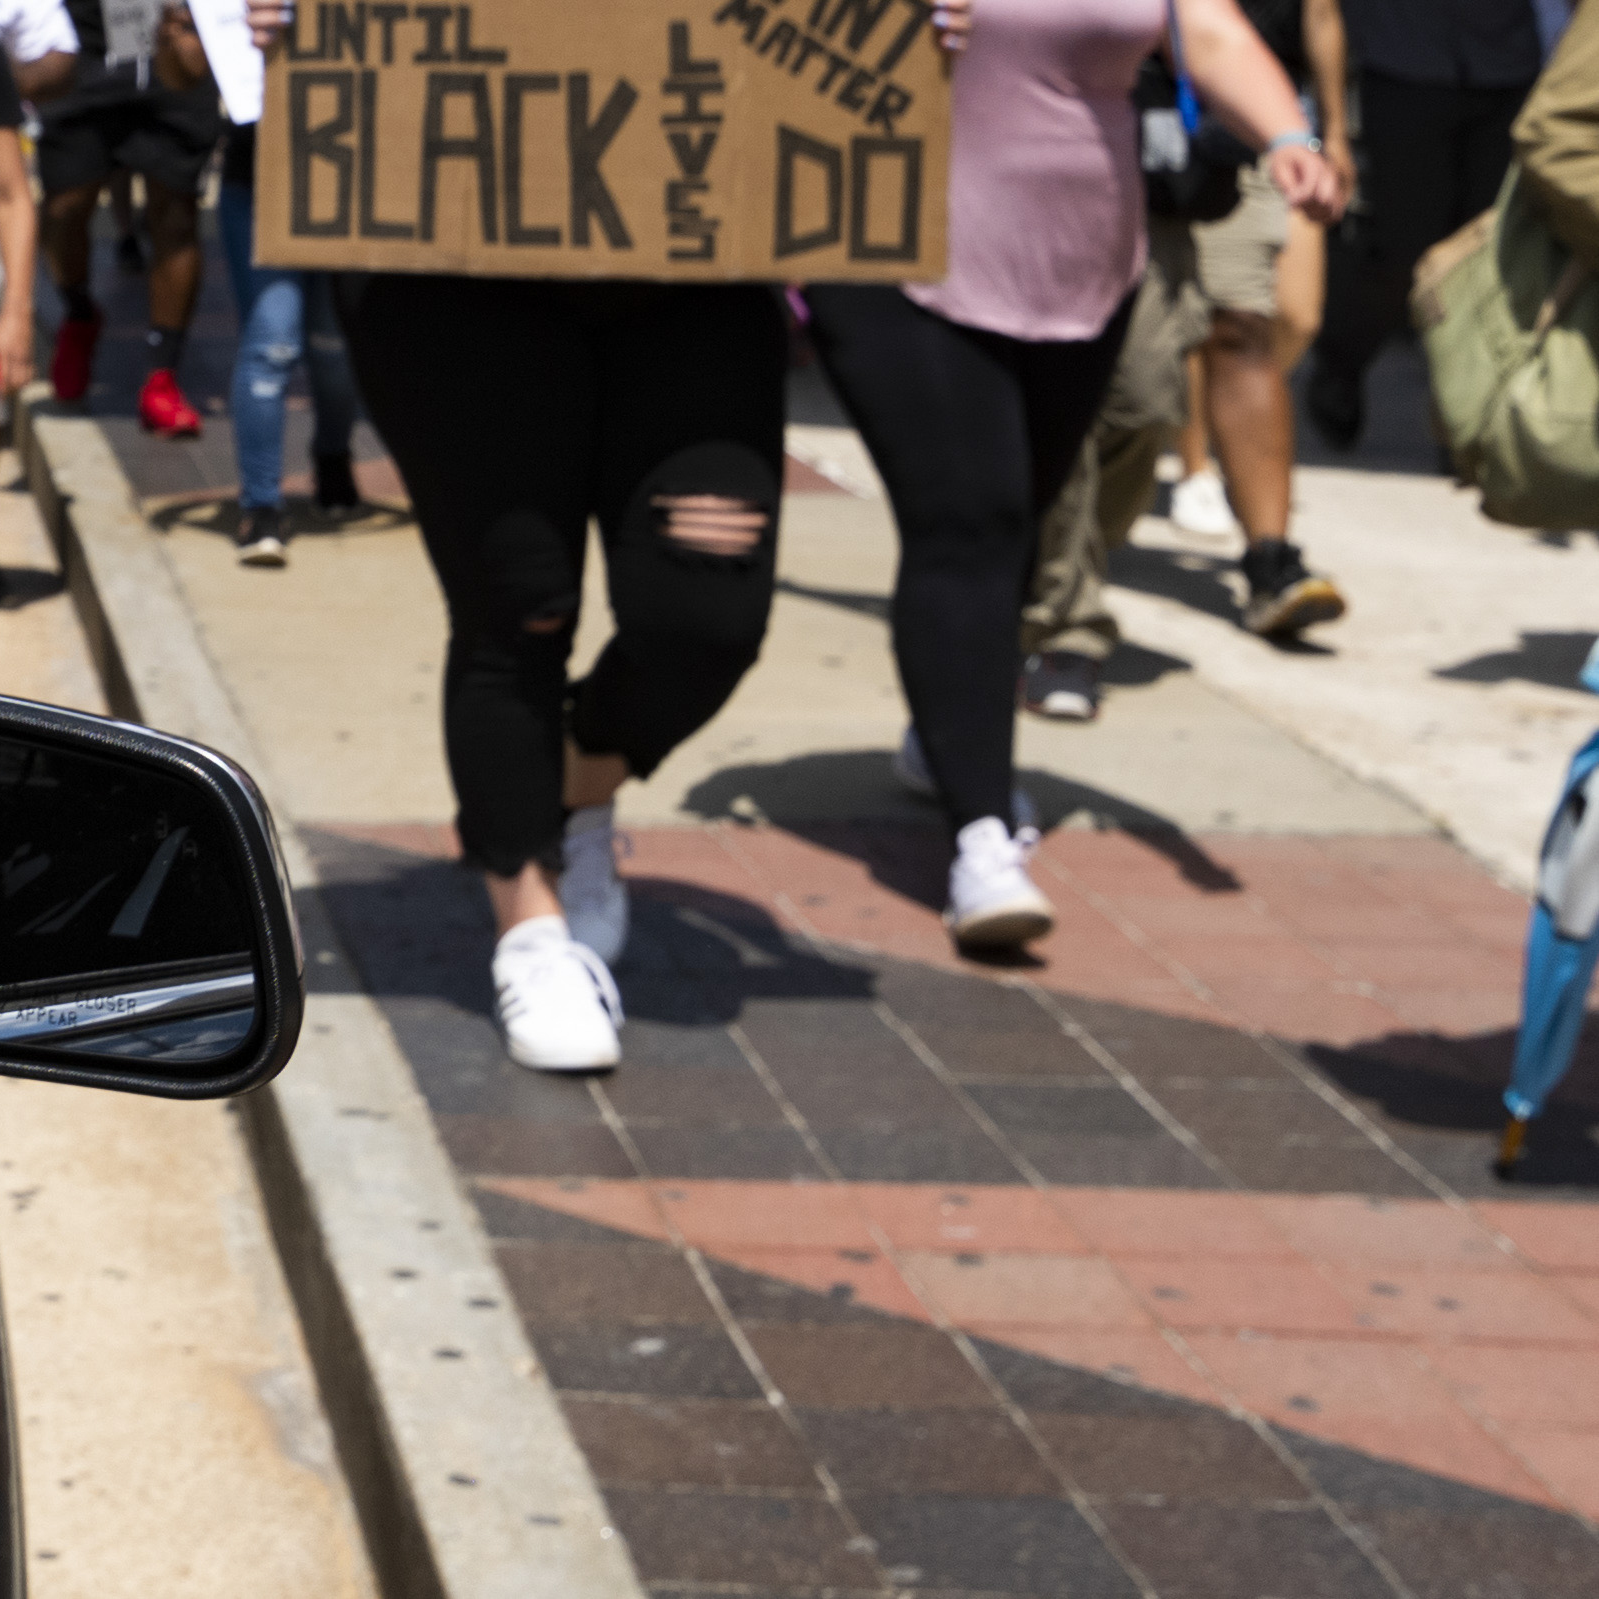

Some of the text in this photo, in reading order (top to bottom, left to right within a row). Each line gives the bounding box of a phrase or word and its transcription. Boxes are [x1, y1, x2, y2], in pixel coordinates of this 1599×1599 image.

[287, 1, 508, 66] UNTIL
[290, 71, 641, 251] BLACK
[774, 123, 924, 262] DO
[14, 1006, 78, 1028] APPEAR
[74, 990, 137, 1016] CLOSER
